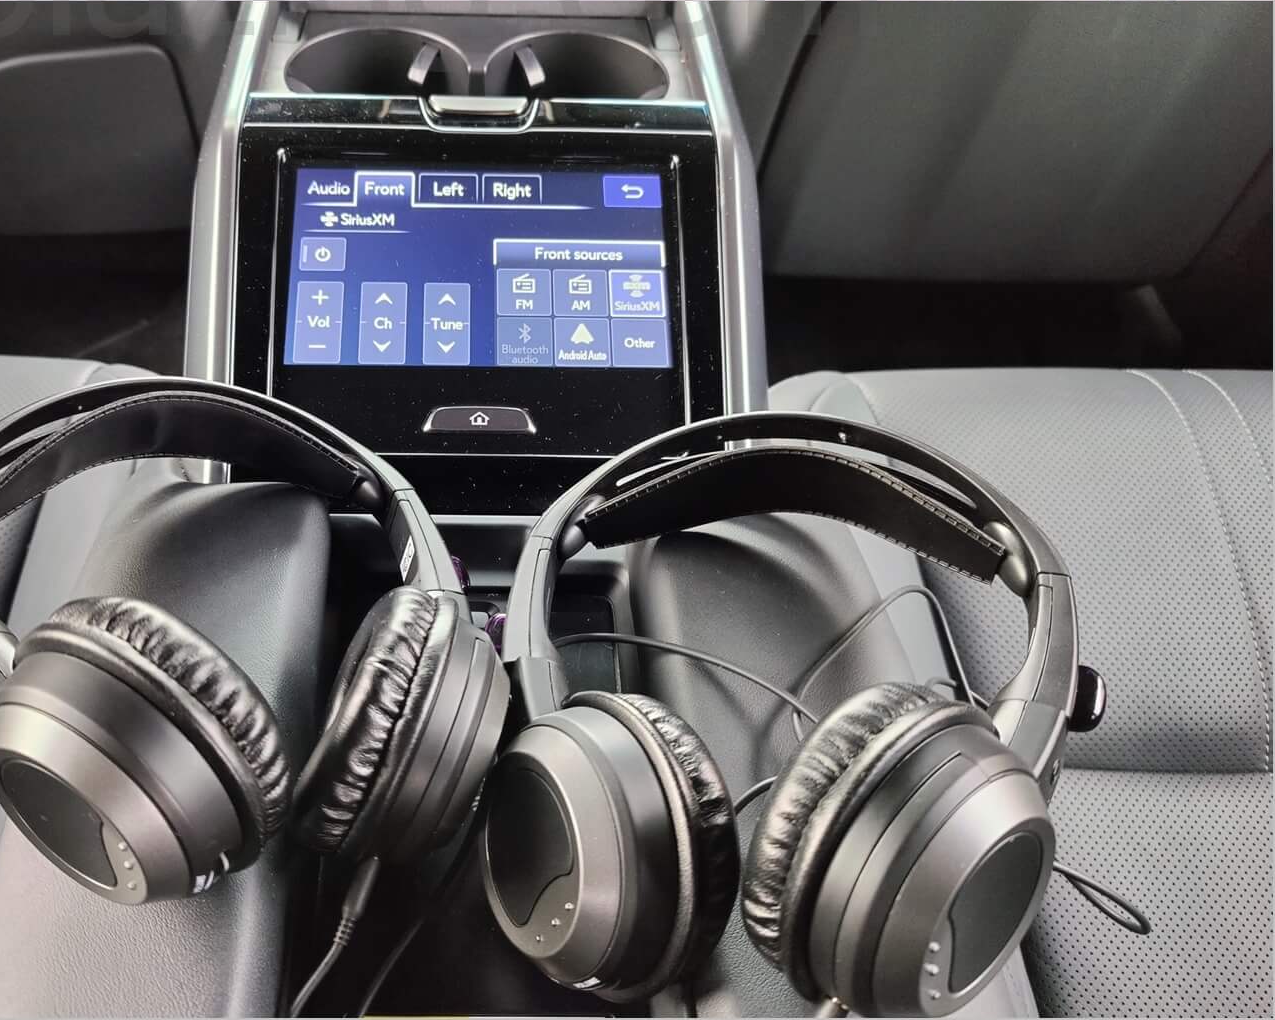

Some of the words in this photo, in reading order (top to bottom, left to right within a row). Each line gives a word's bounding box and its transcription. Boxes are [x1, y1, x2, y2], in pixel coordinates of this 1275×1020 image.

[307, 181, 351, 196] Audio
[363, 181, 405, 197] Front
[433, 182, 465, 198] Left
[493, 182, 532, 200] Right
[340, 212, 395, 227] SiriusXM
[535, 248, 567, 262] Front
[570, 249, 623, 262] sources
[515, 300, 533, 311] FM
[571, 300, 591, 312] AM
[613, 300, 661, 313] SiriusXM
[307, 315, 331, 329] Vol
[373, 316, 393, 330] Ch
[431, 318, 464, 331] Tune
[624, 336, 656, 349] Other
[501, 343, 549, 356] Bluetooth
[558, 349, 586, 361] Android
[587, 350, 607, 362] Auto
[511, 354, 539, 365] audio
